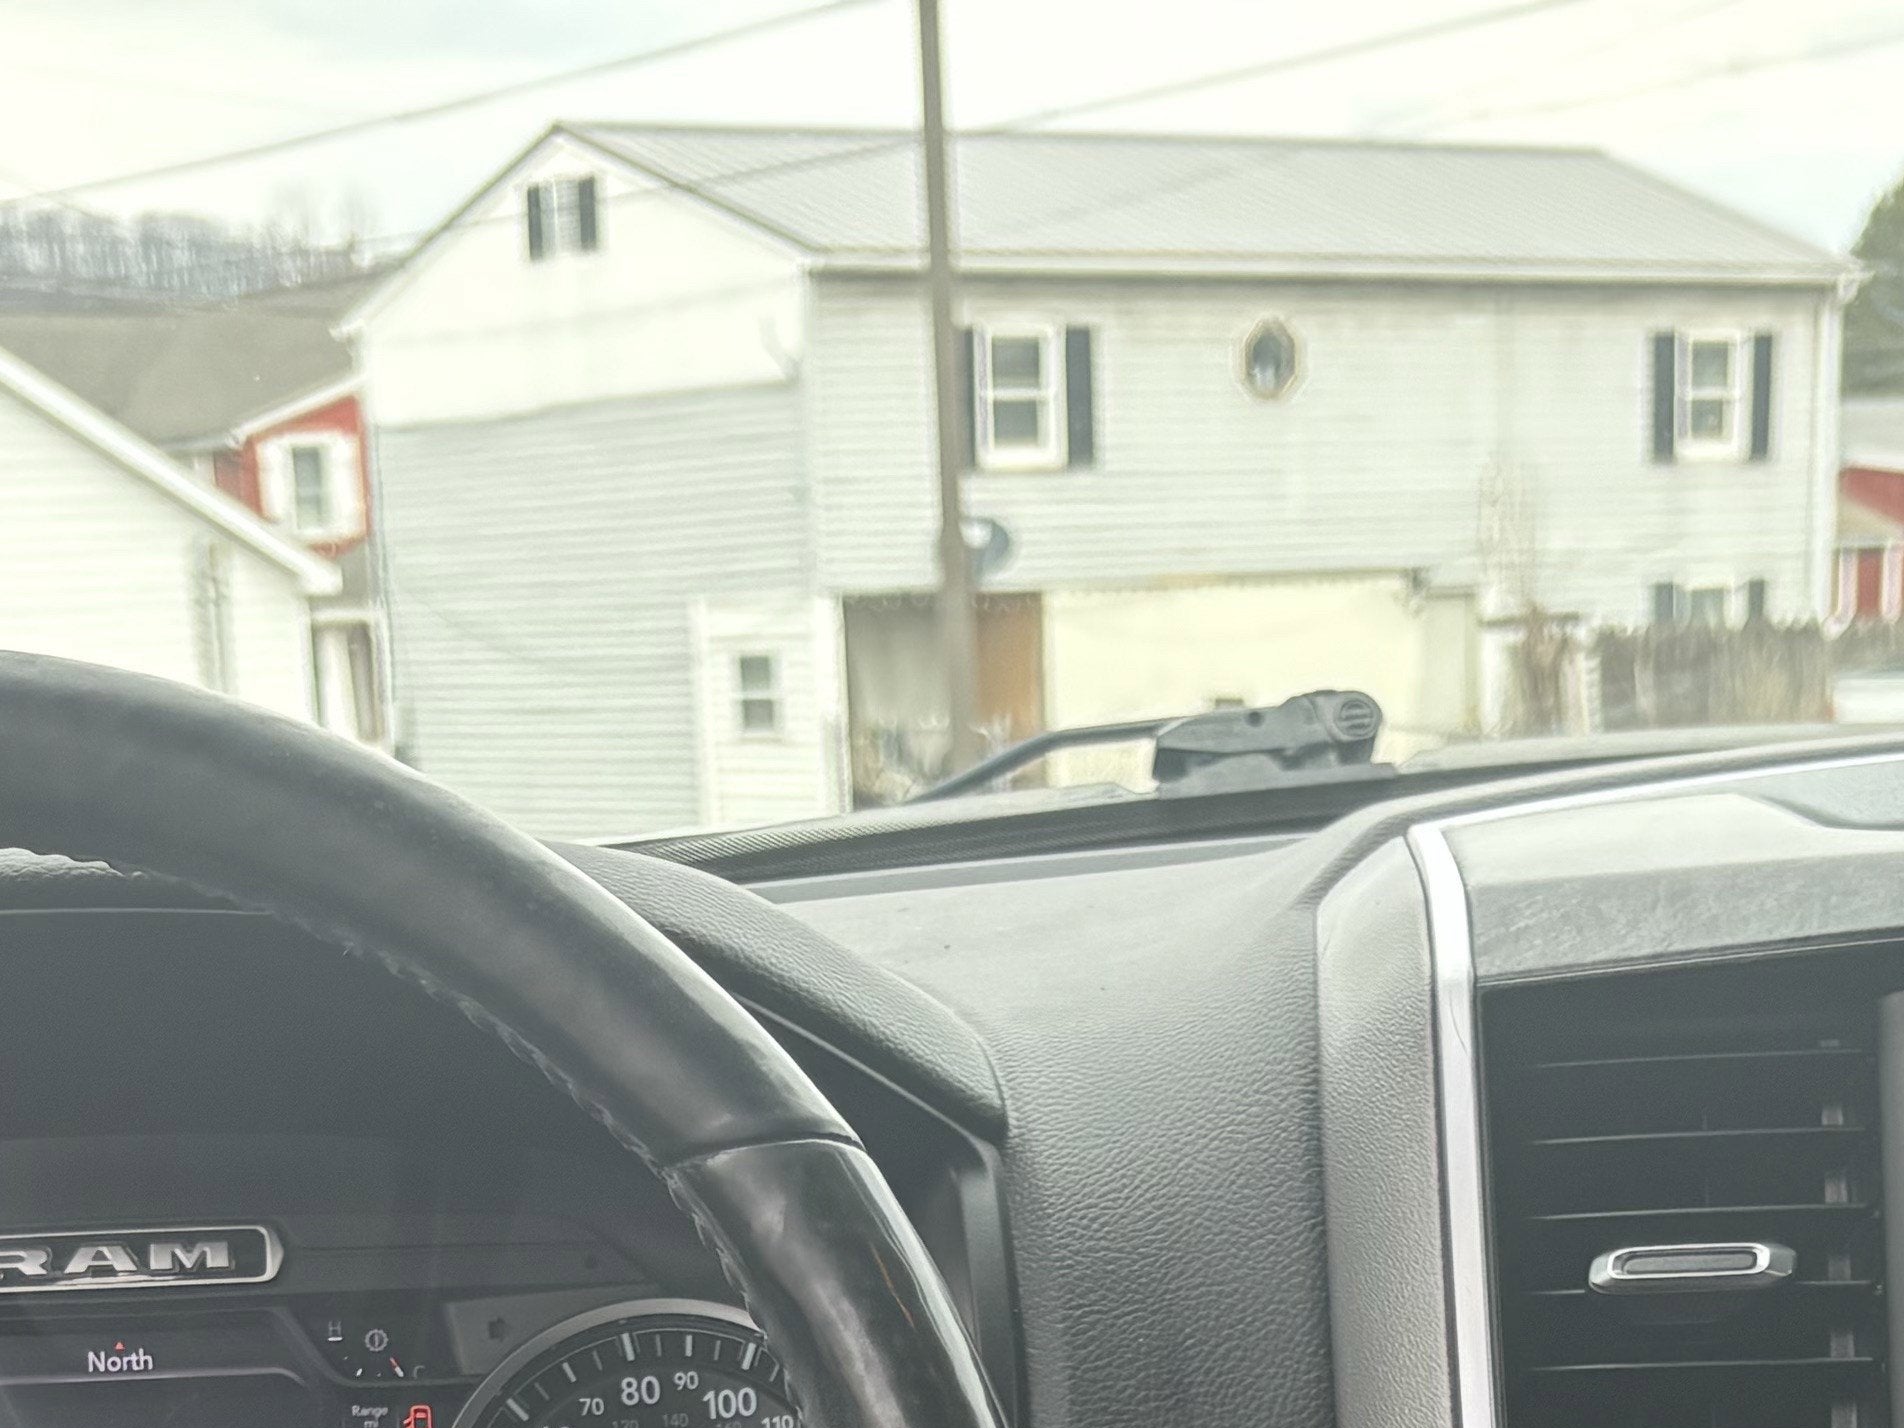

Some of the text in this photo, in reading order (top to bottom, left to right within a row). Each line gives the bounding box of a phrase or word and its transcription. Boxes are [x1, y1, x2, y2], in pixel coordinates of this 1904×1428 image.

[87, 1349, 153, 1372] North
[621, 1376, 660, 1405] 80
[674, 1371, 698, 1390] 90
[351, 1405, 389, 1418] Range
[580, 1398, 604, 1416] 70
[703, 1387, 757, 1419] 100
